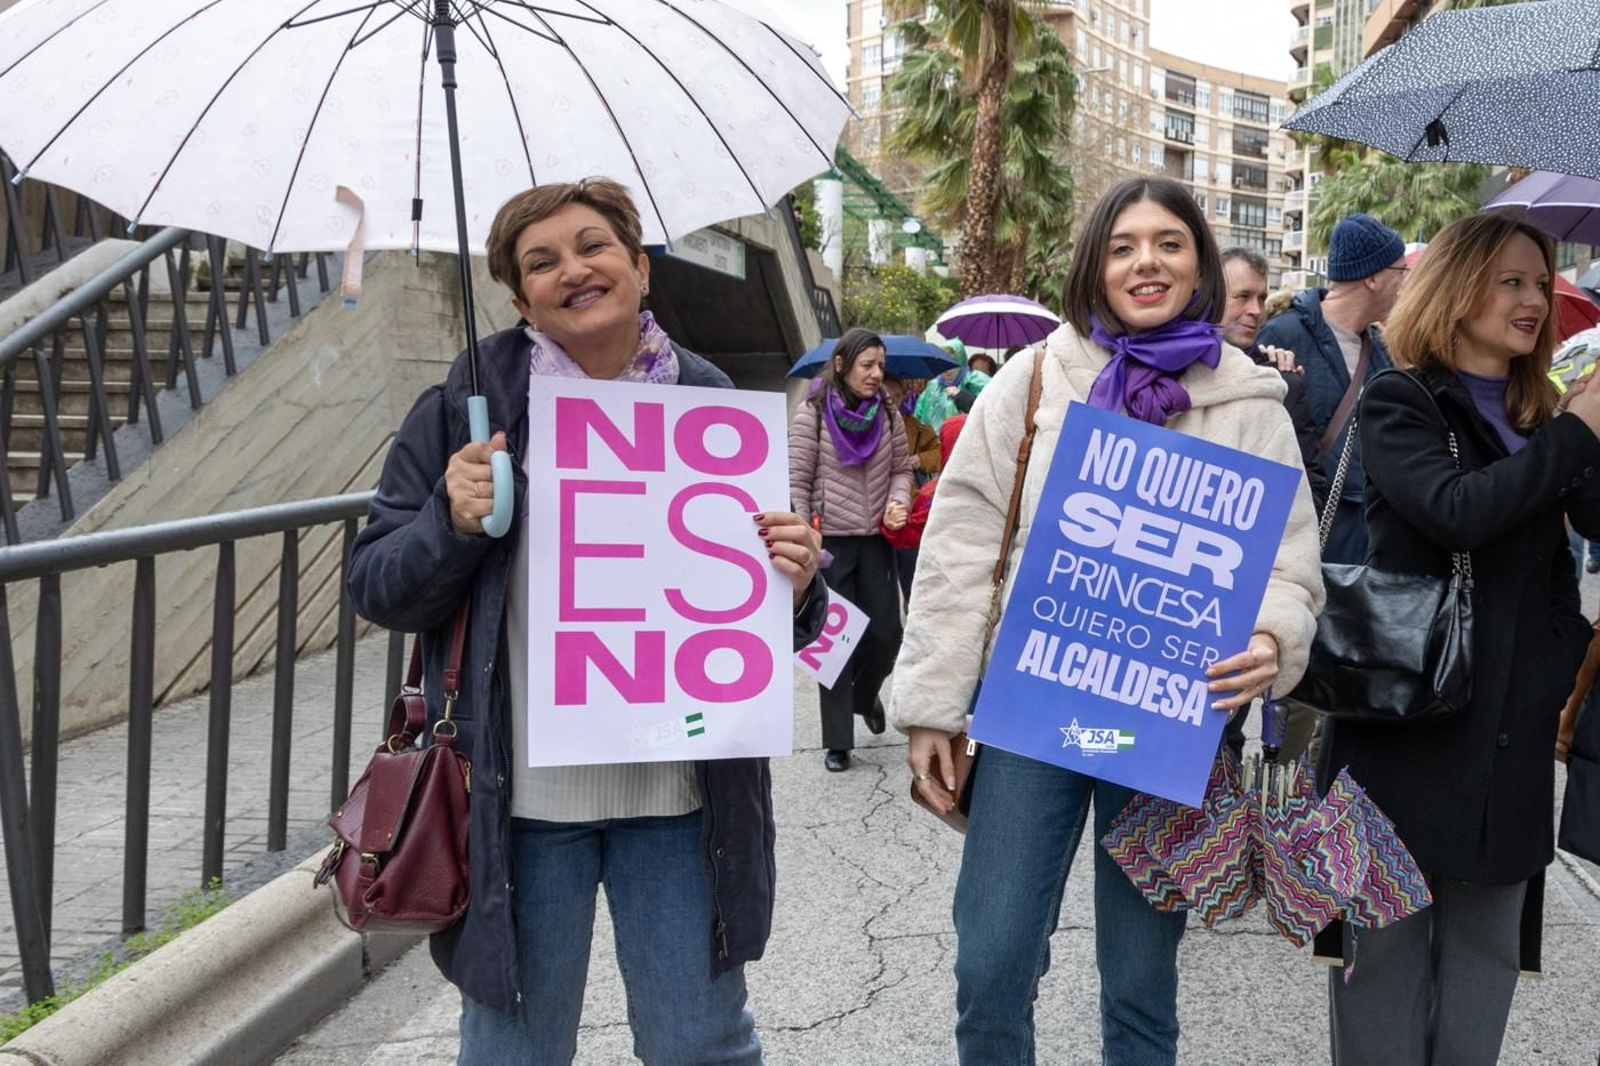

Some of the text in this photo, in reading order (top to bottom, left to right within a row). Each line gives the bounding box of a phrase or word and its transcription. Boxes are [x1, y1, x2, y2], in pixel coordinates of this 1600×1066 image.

[555, 396, 769, 477] NO
[1078, 427, 1266, 532] NO QUIERO
[558, 478, 769, 625] ES
[1058, 491, 1245, 591] SER
[1032, 595, 1220, 669] QUIERO SER
[1046, 547, 1223, 638] PRINCESA
[554, 629, 774, 707] NO
[798, 602, 848, 671] NO
[1015, 629, 1209, 727] ALCALDESA
[656, 720, 684, 741] JSA
[1087, 730, 1115, 745] JSA
